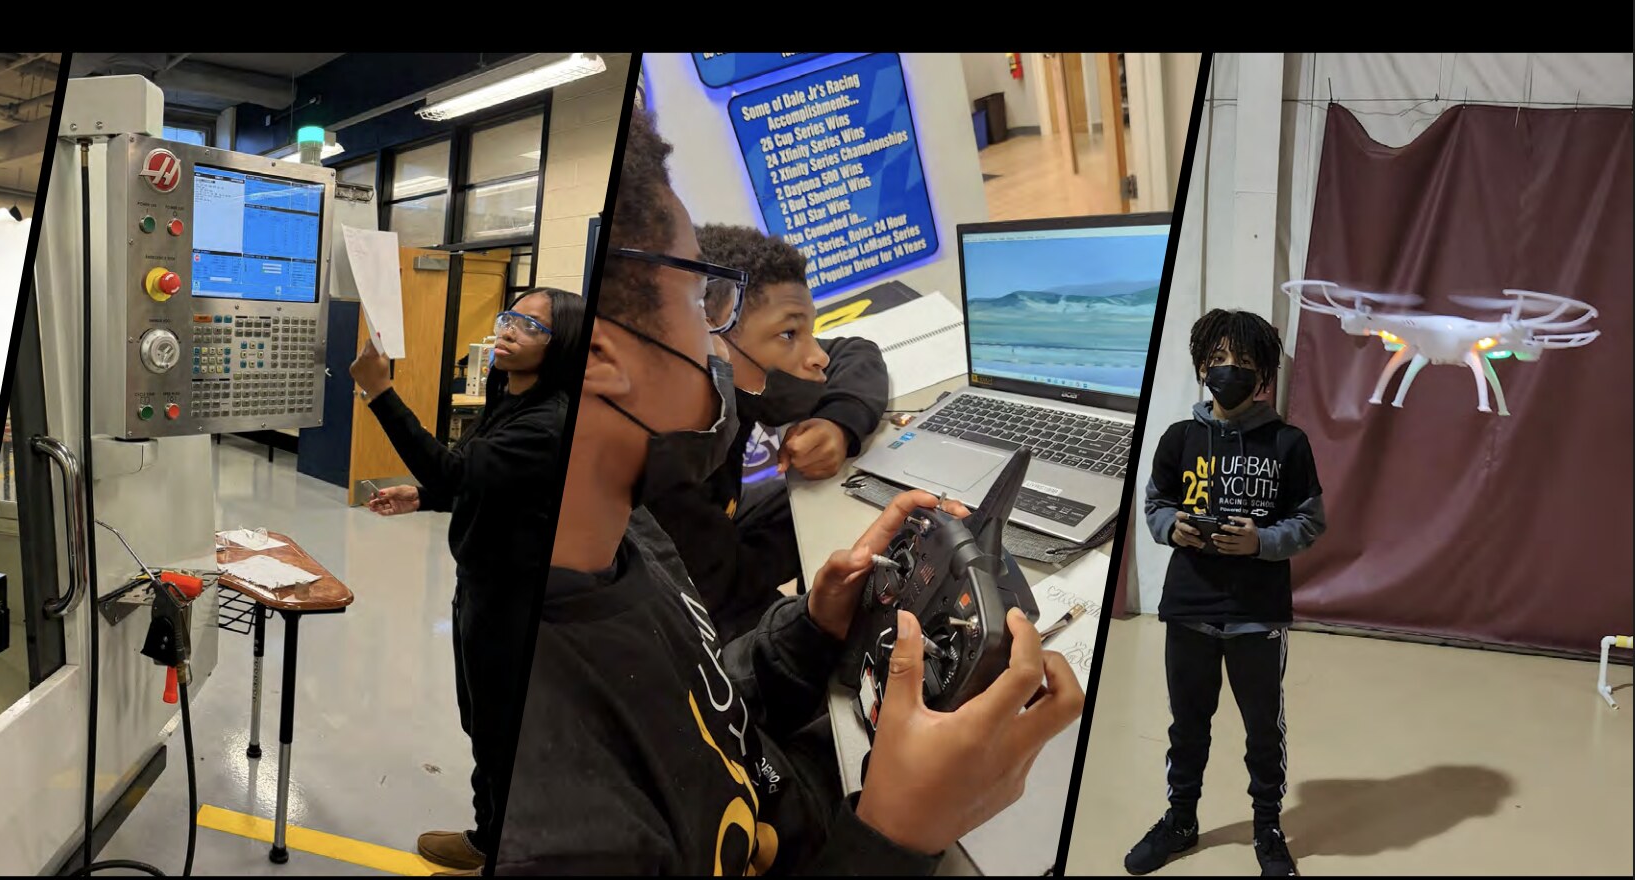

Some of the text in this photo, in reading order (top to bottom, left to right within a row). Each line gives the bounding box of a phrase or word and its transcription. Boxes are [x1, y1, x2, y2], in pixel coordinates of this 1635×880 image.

[741, 73, 861, 121] Some of Dale Jr's Racing
[767, 94, 860, 132] Accomplishments...
[760, 114, 850, 153] 26 Cup Series Wins
[765, 127, 866, 169] 24 Xfinity Series Wins
[770, 130, 908, 184] 2 Xfinity Series Championships
[775, 162, 864, 200] 2 Daytona 500 Wins
[780, 175, 872, 215] 2 Bud Shootout Wins
[783, 232, 804, 246] Also
[804, 215, 848, 241] Competed
[785, 199, 851, 230] 2 All Star Wins
[817, 235, 849, 254] Series,
[848, 226, 874, 243] Rolex
[874, 220, 887, 232] 24
[886, 213, 908, 229] Hour
[818, 245, 860, 269] American
[859, 234, 893, 254] LeMans
[892, 225, 921, 242] Series
[819, 262, 853, 285] Popular
[853, 255, 880, 272] Driver
[880, 250, 893, 263] for
[893, 245, 905, 258] 14
[903, 238, 927, 254] Years
[1221, 456, 1281, 479] URBAN
[1218, 497, 1275, 508] RACING SCHOOL
[1220, 476, 1280, 499] YOUTH
